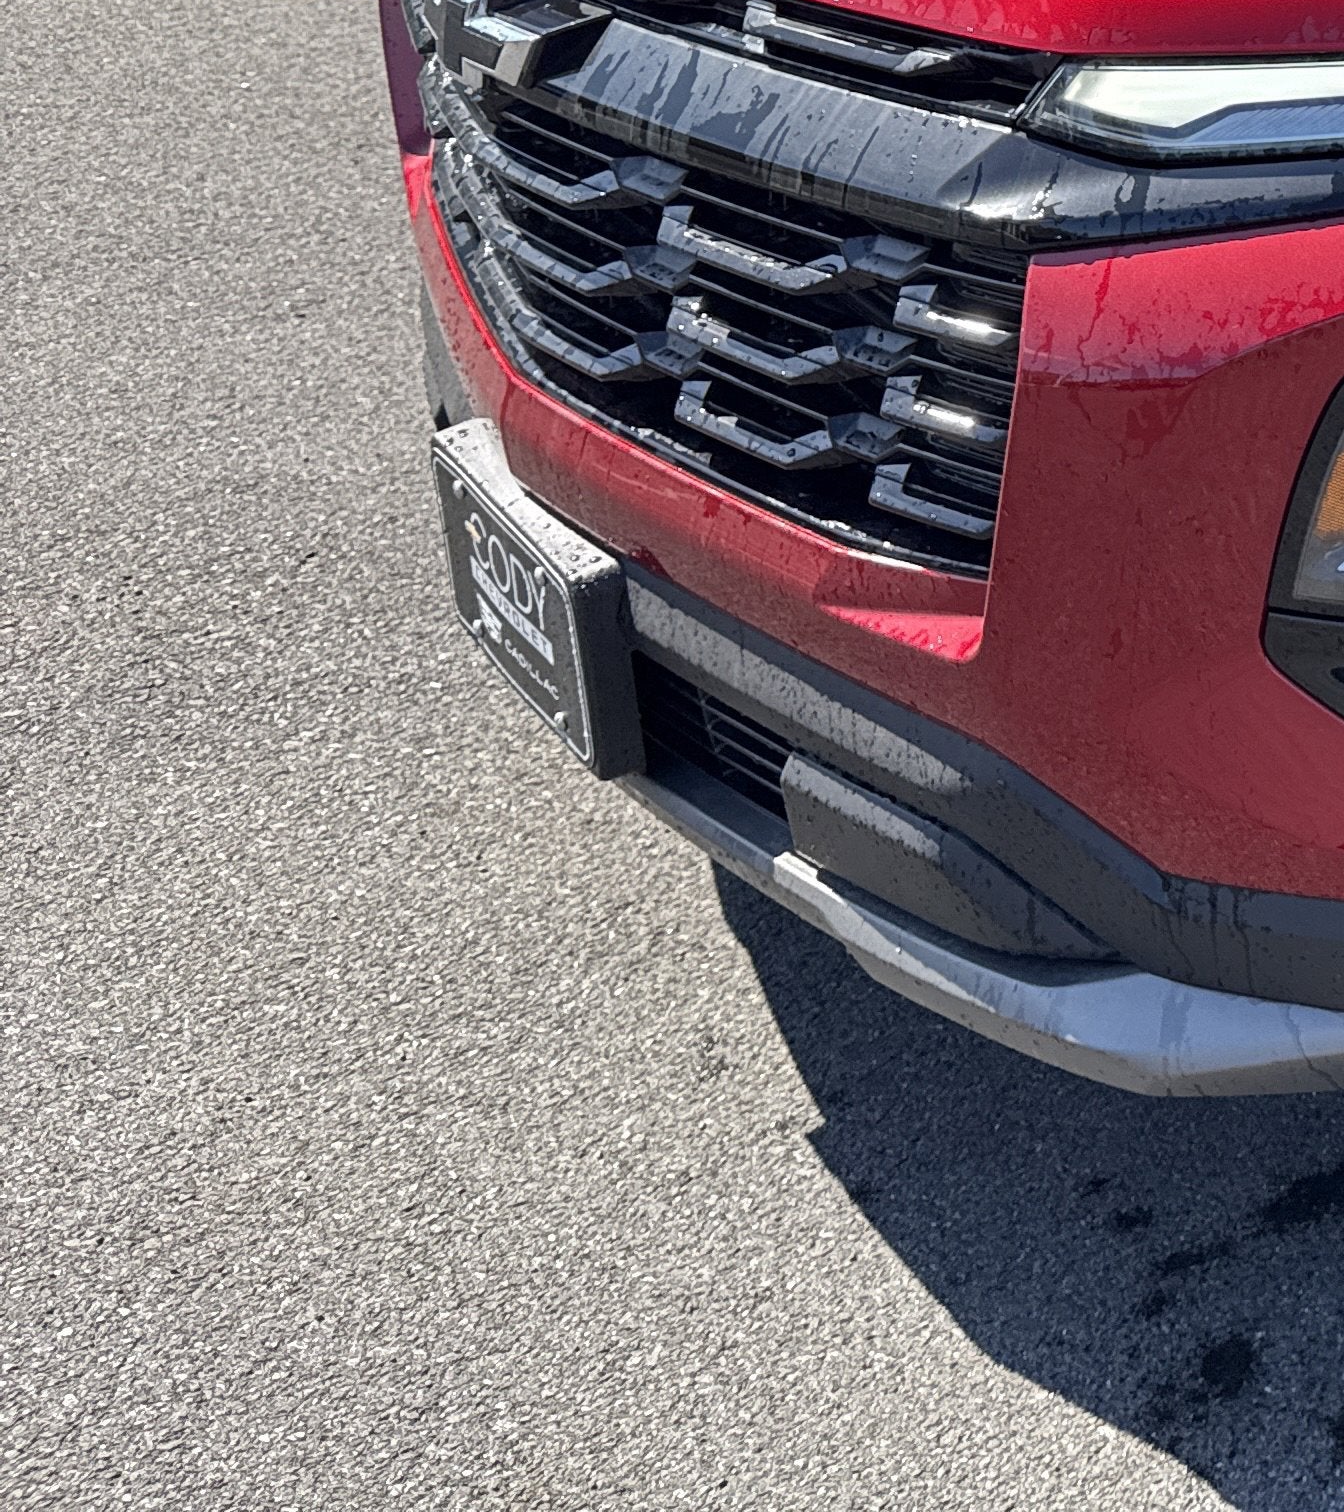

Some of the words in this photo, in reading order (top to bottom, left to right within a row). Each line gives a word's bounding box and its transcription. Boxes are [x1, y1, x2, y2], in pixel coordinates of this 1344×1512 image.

[470, 512, 546, 631] CODY
[474, 562, 550, 656] CHEVROLET
[504, 638, 560, 701] CADILLAC
